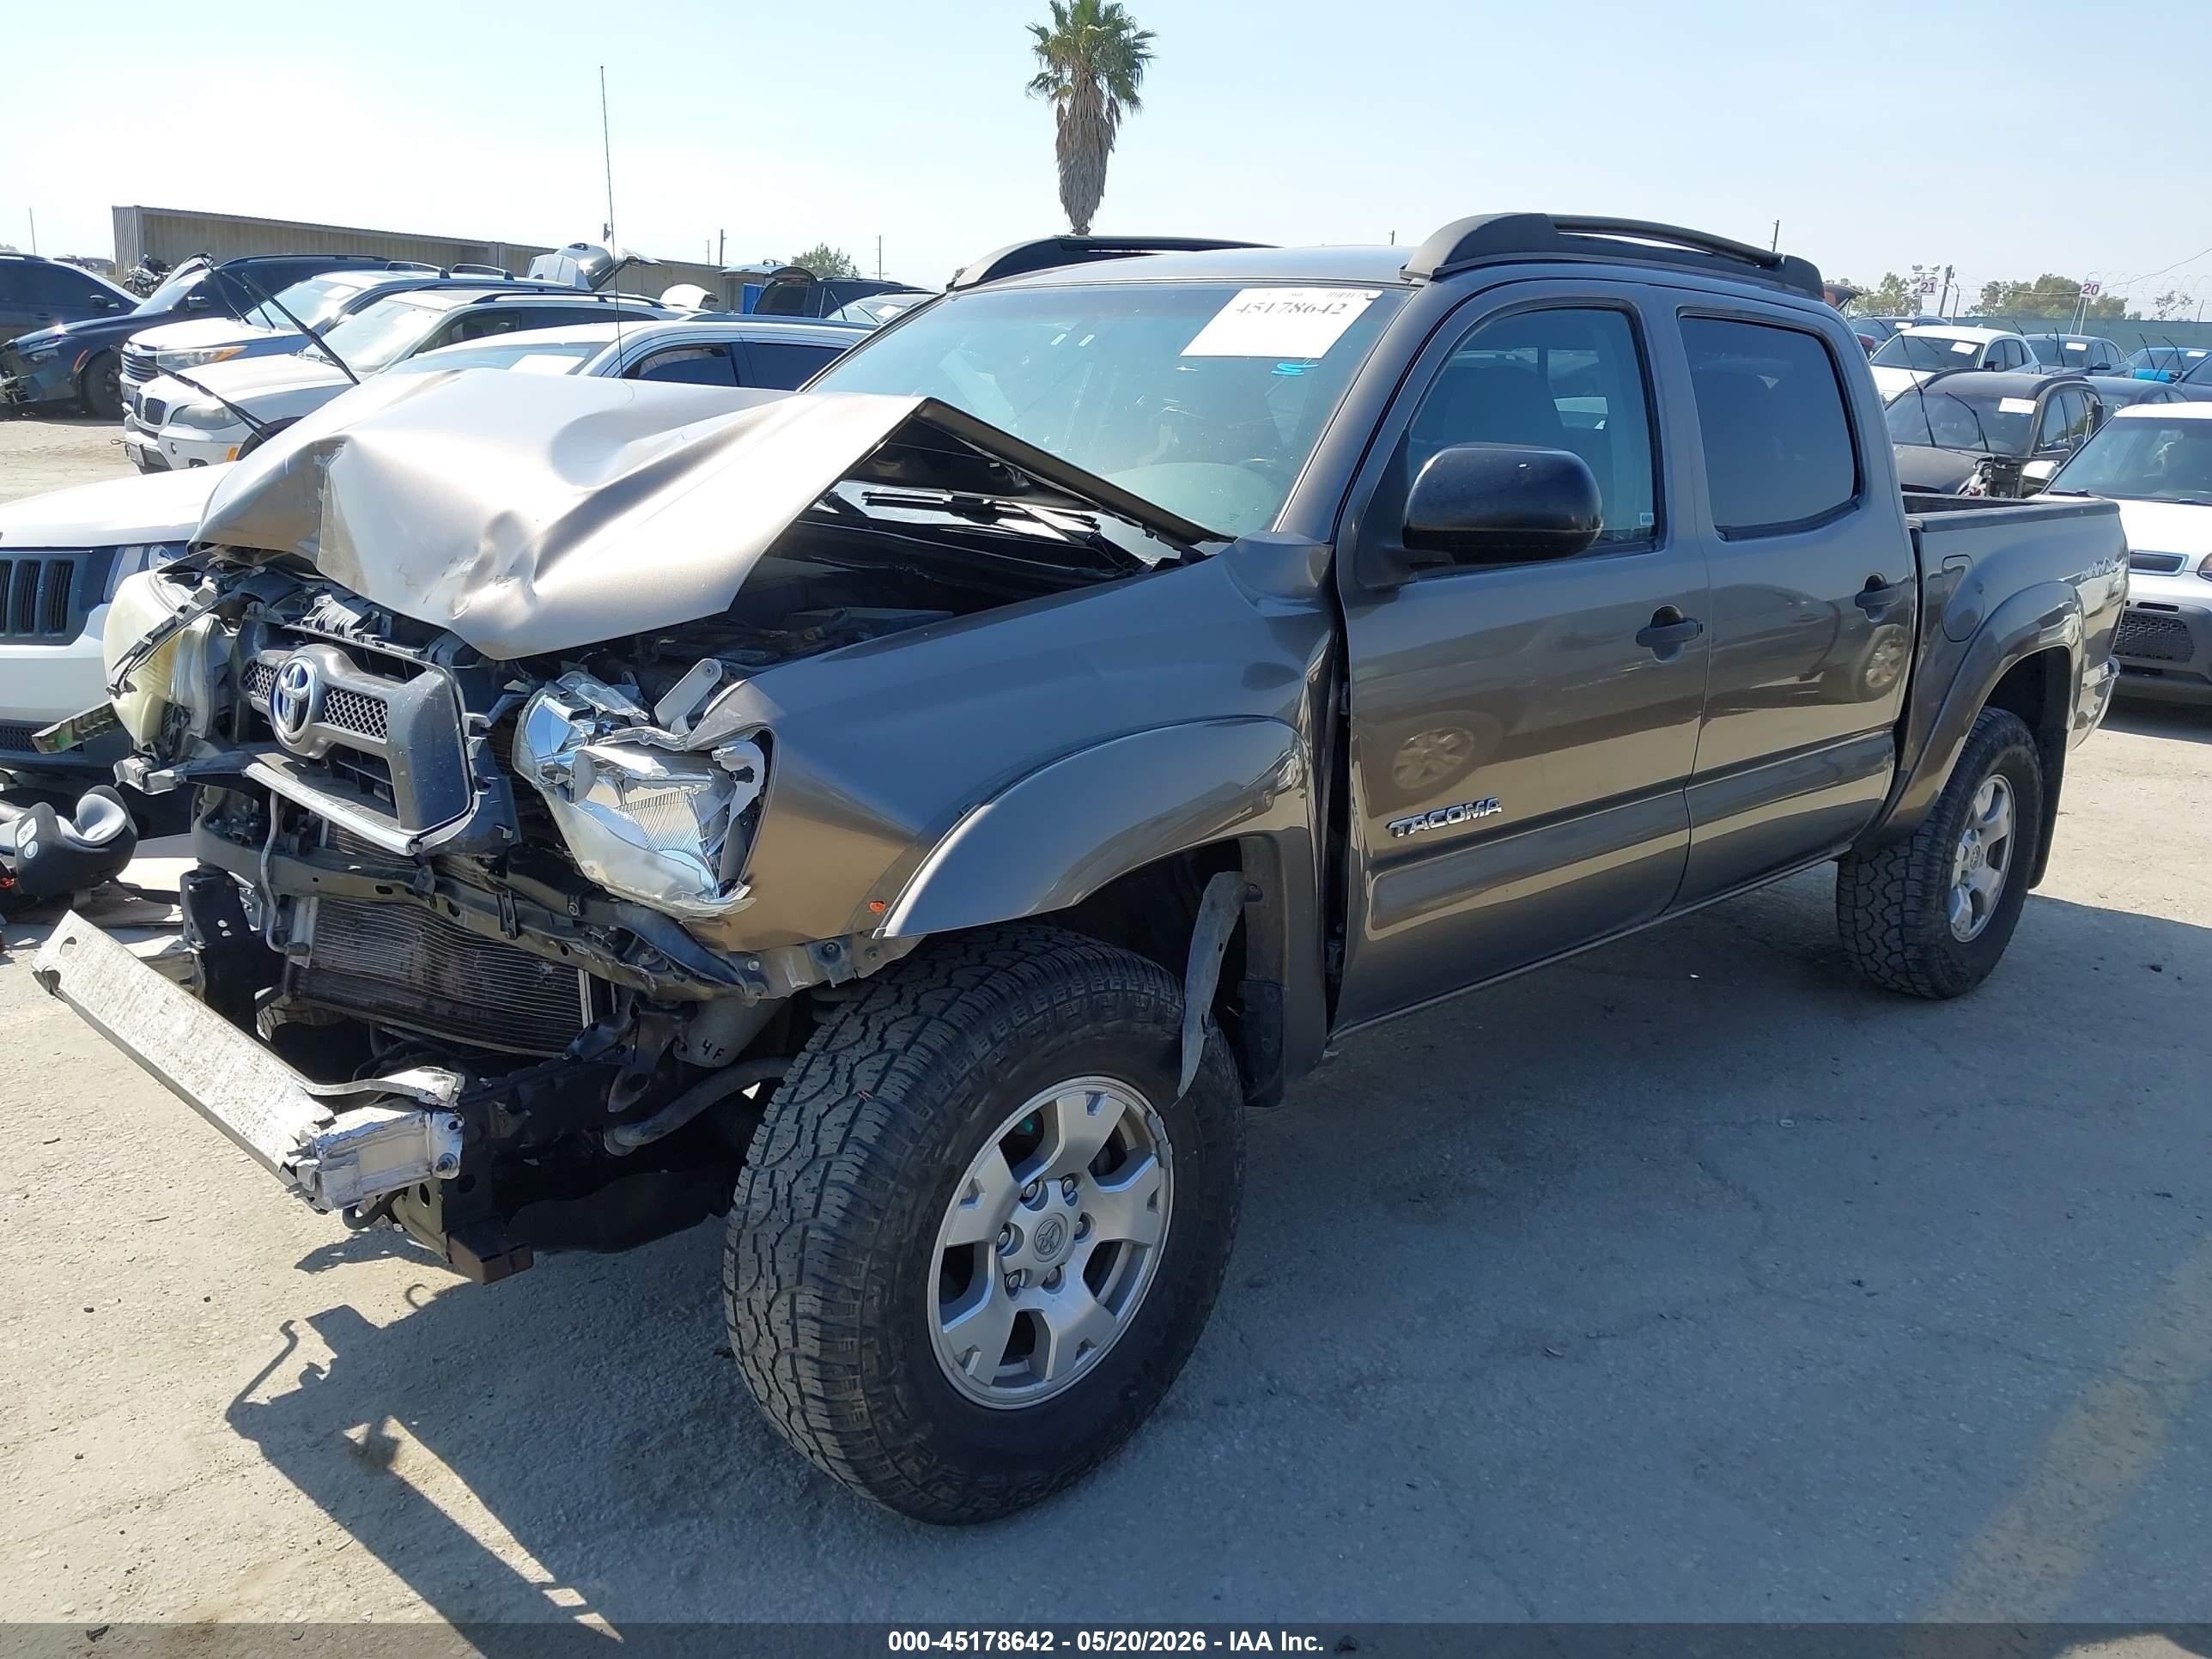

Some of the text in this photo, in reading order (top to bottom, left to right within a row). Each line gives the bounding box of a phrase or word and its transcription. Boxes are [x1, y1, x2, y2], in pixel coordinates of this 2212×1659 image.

[1920, 282, 1936, 294] 21
[2081, 283, 2100, 295] 20
[1236, 301, 1348, 313] 45178642
[1385, 797, 1504, 837] TACOMA
